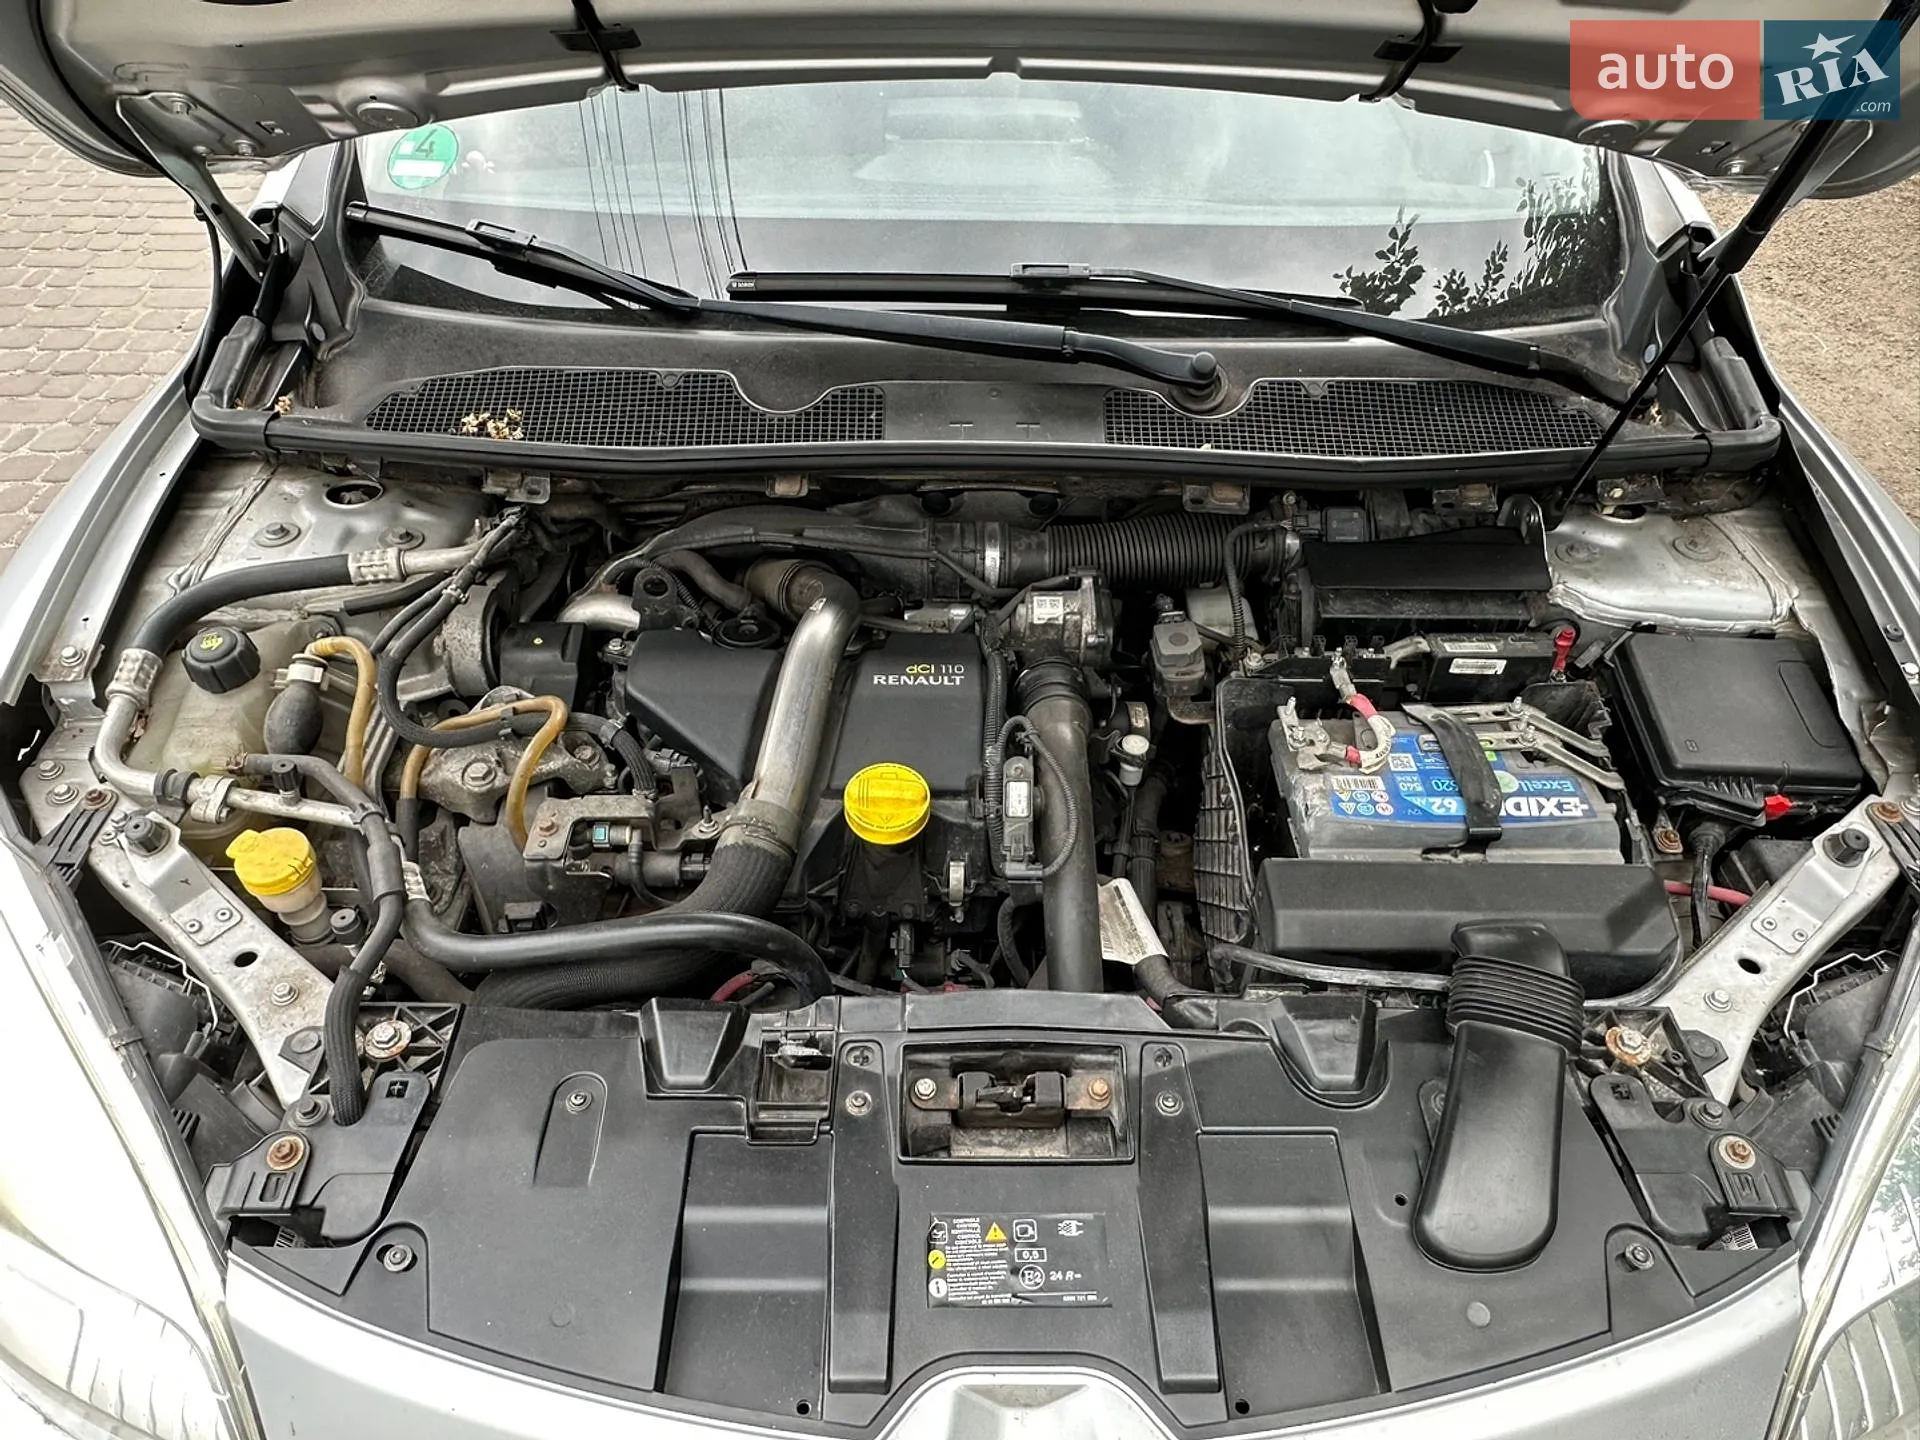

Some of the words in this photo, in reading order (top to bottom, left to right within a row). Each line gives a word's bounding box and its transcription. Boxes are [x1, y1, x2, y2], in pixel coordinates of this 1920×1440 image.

[415, 128, 437, 158] 4
[941, 664, 964, 674] 110
[873, 675, 965, 686] RENAULT
[1518, 780, 1576, 792] Excell
[1431, 798, 1458, 814] 62
[1499, 796, 1588, 817] EXID
